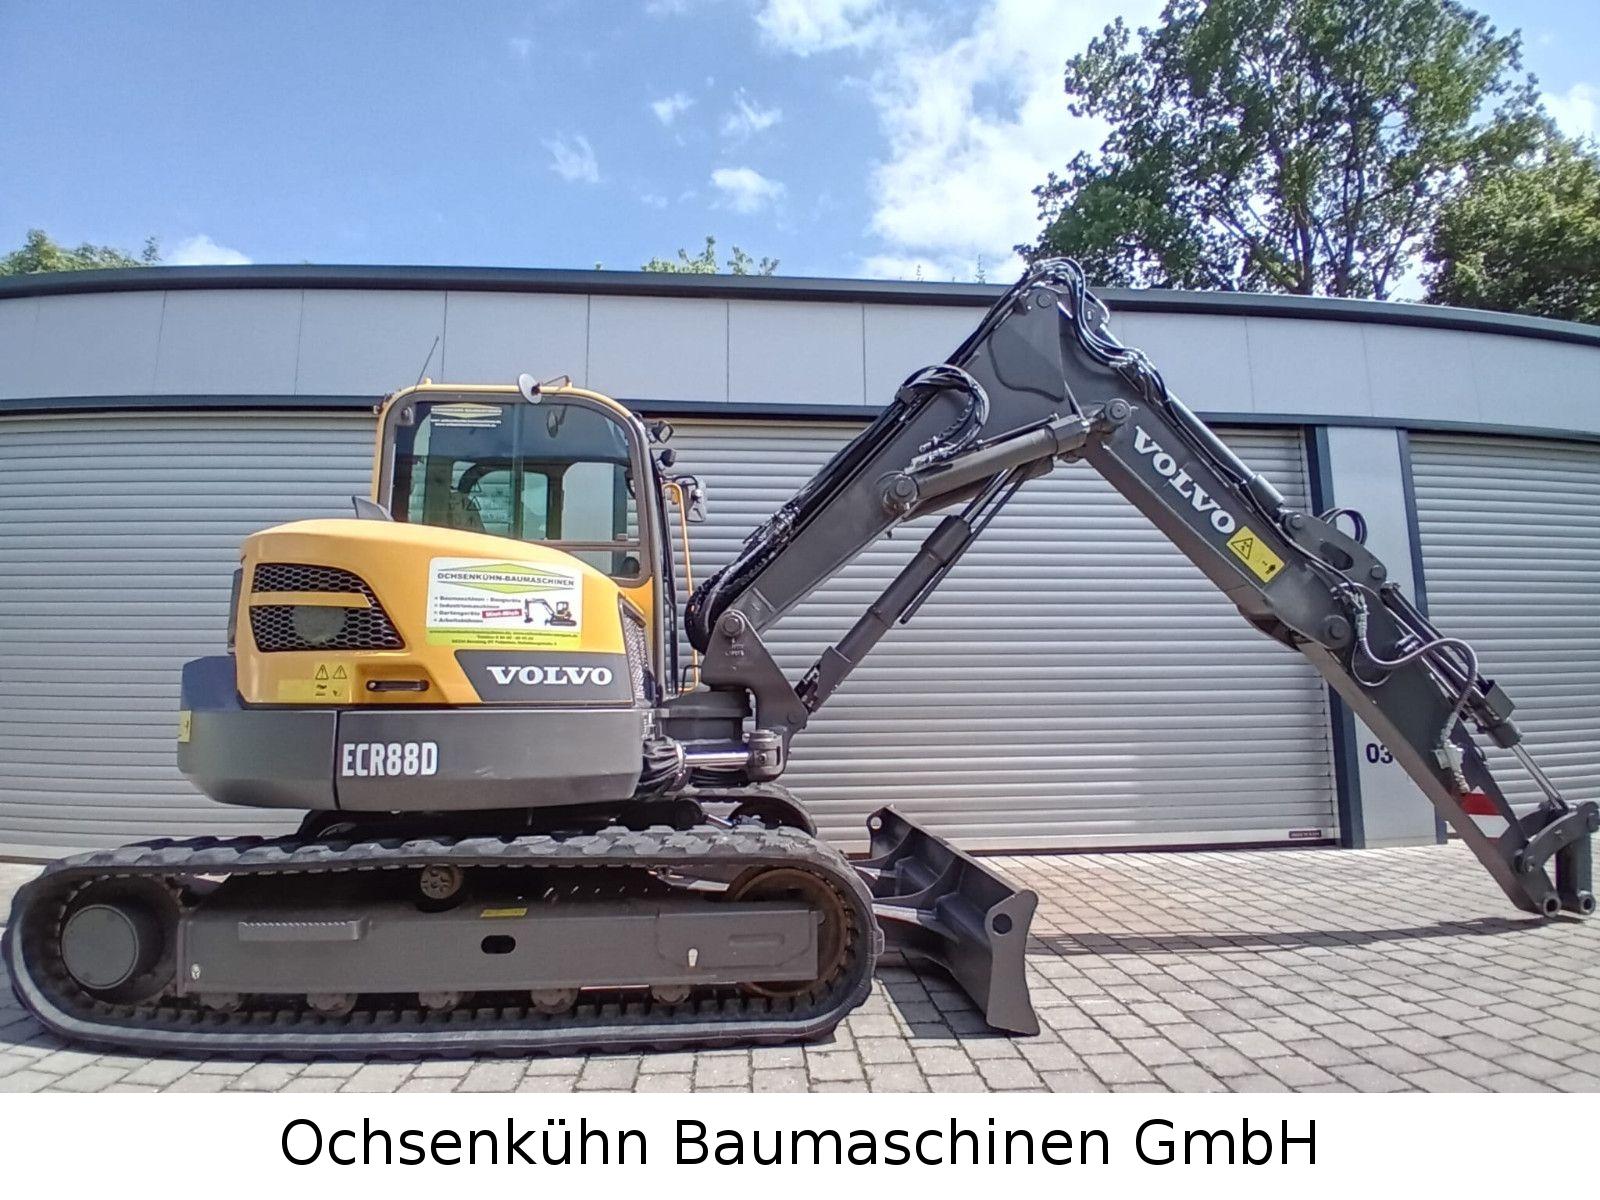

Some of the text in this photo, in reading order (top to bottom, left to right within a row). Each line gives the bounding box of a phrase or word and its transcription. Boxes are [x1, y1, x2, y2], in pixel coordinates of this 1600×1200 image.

[1133, 426, 1236, 534] VOLVO
[437, 571, 575, 587] OCHSENKÜHN-BAUMASCHINEN
[486, 666, 613, 686] VOLVO
[341, 742, 439, 777] ECR88D
[1366, 743, 1394, 764] 03
